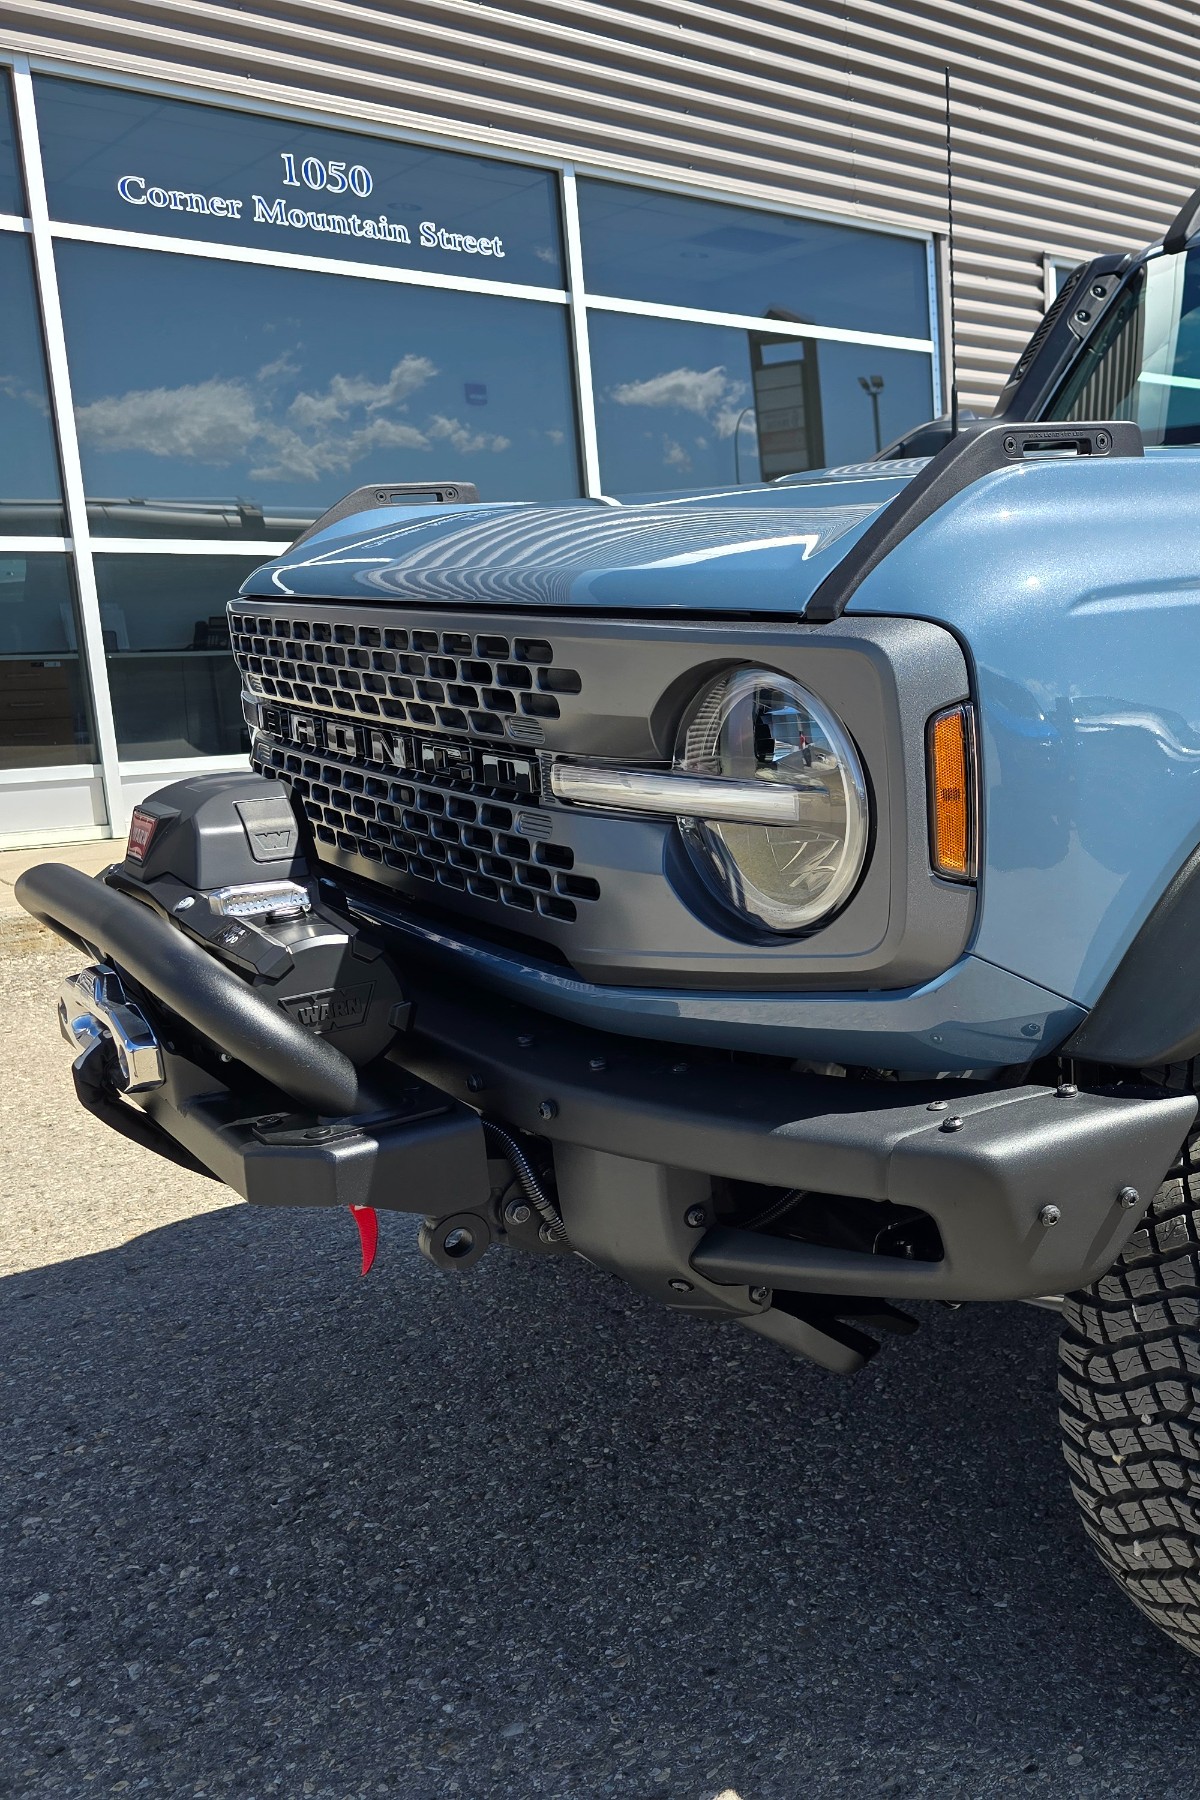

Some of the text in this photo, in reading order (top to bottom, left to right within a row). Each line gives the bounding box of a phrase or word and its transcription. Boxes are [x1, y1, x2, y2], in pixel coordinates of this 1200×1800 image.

[280, 152, 373, 198] 1050
[117, 175, 506, 258] Corner Mountain Street
[258, 703, 542, 796] BRONCO
[297, 997, 364, 1026] WARN
